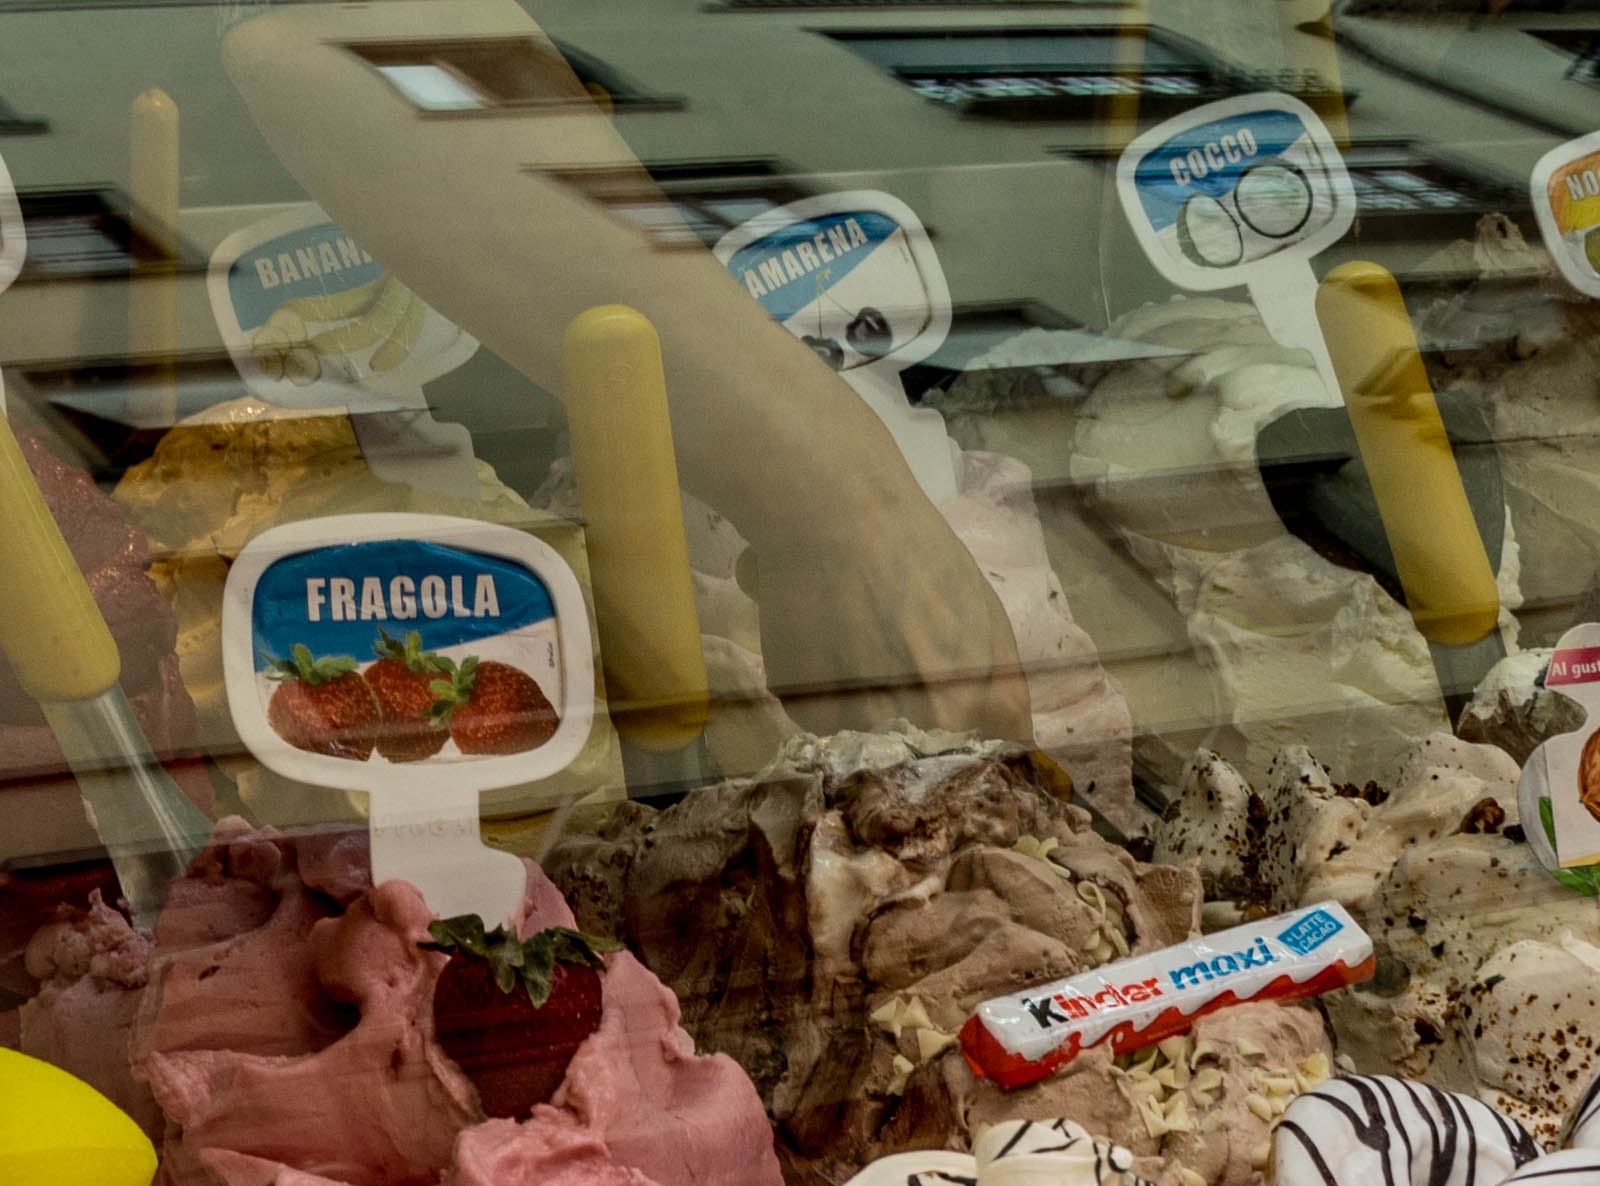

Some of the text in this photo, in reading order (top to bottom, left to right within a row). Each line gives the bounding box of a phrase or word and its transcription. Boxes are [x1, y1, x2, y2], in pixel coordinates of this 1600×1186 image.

[1169, 128, 1258, 186] COCCO
[744, 217, 869, 298] AMARENA
[306, 574, 500, 622] FRAGOLA
[1552, 661, 1567, 677] Al
[1291, 913, 1326, 941] LATTE
[1299, 920, 1337, 952] CACAO
[1168, 936, 1280, 990] maxi
